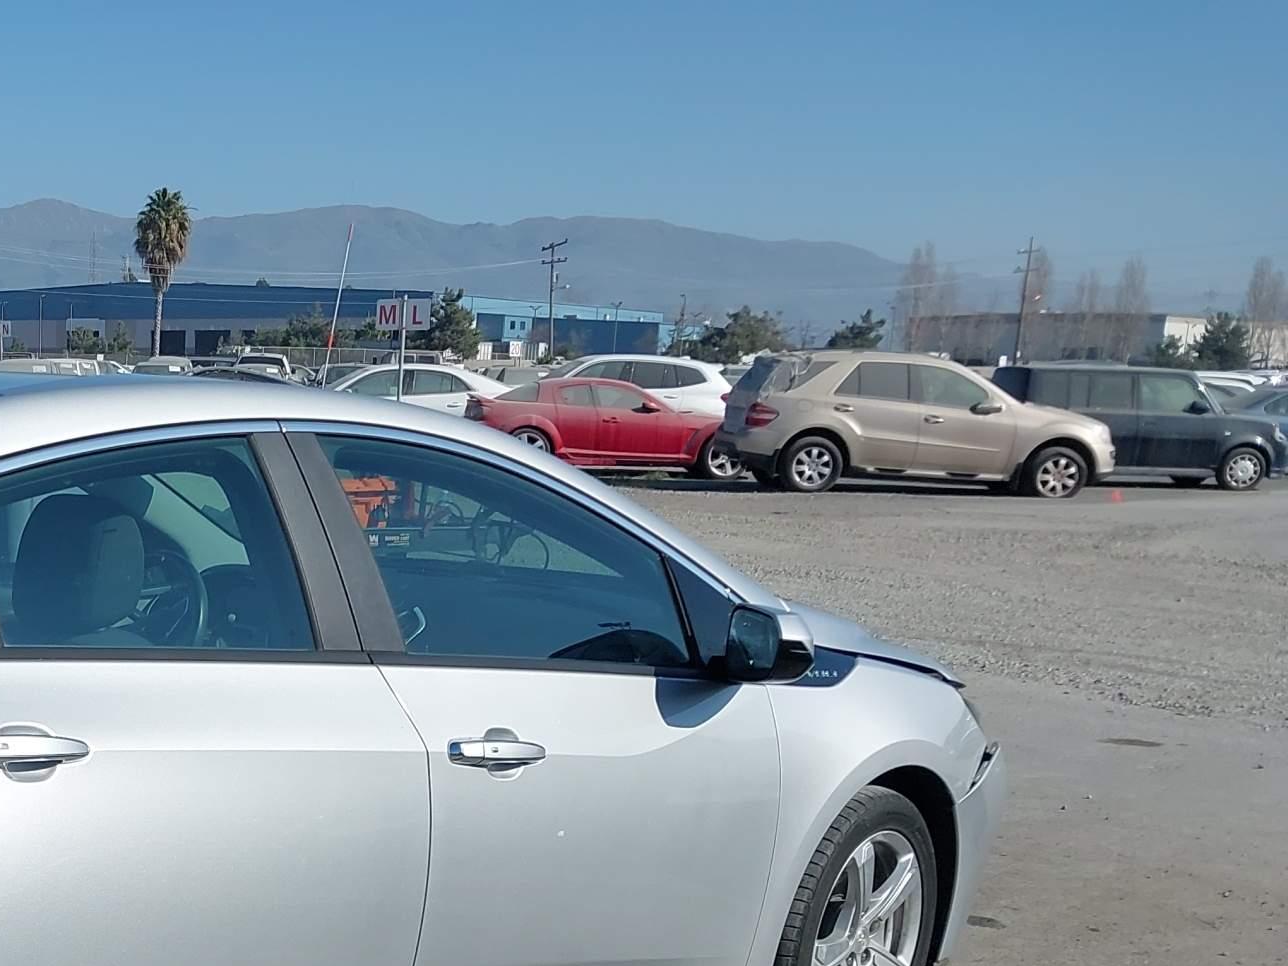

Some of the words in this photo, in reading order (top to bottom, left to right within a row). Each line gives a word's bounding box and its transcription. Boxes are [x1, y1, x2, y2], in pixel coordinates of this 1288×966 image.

[378, 304, 397, 325] M
[412, 304, 423, 325] L
[3, 324, 9, 335] N
